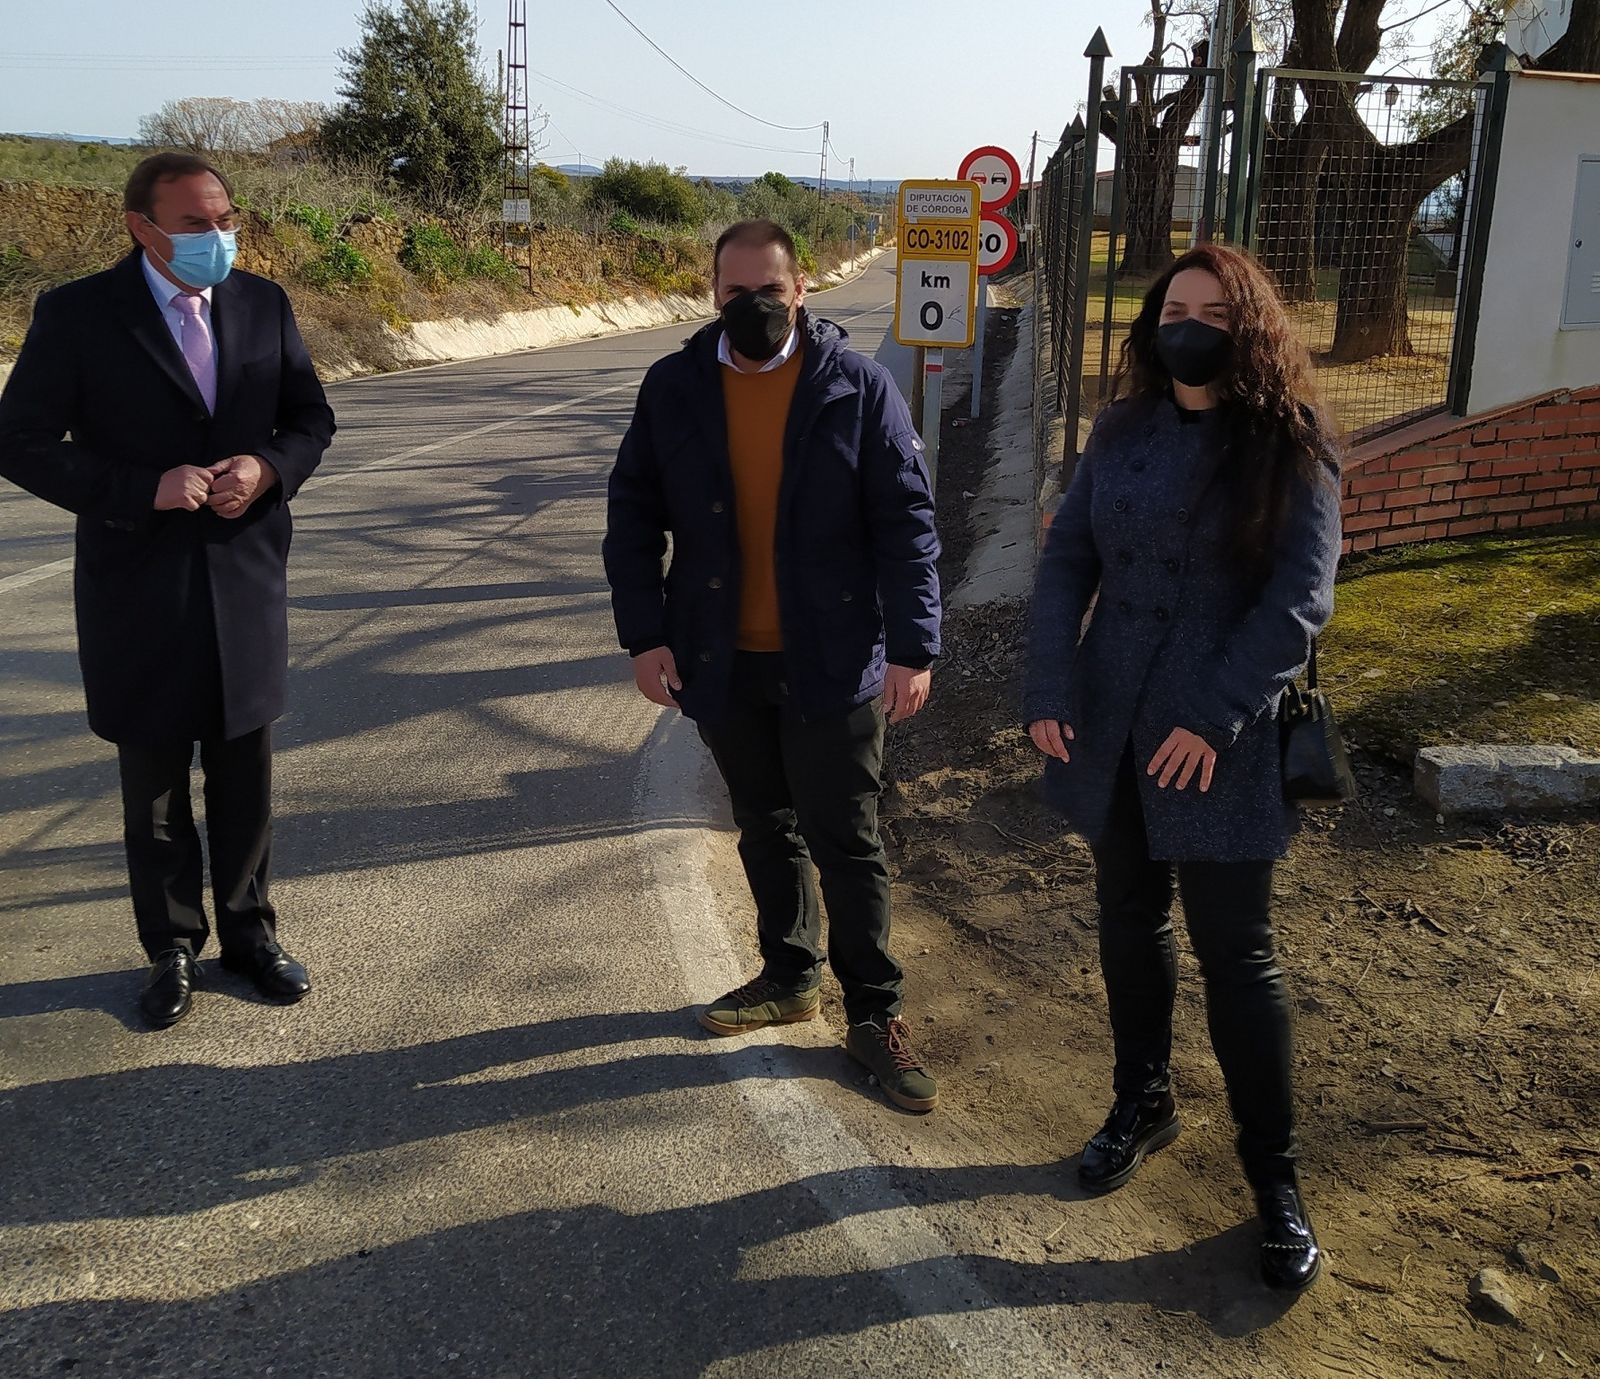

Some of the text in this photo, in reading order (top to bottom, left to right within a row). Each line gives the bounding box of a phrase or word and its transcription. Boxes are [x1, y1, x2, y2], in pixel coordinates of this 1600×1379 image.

[910, 193, 966, 203] DIPUTACIÓN
[906, 203, 968, 214] DE CÓRDOBA
[907, 228, 969, 250] CO-3102
[921, 271, 950, 288] km
[920, 301, 943, 331] 0
